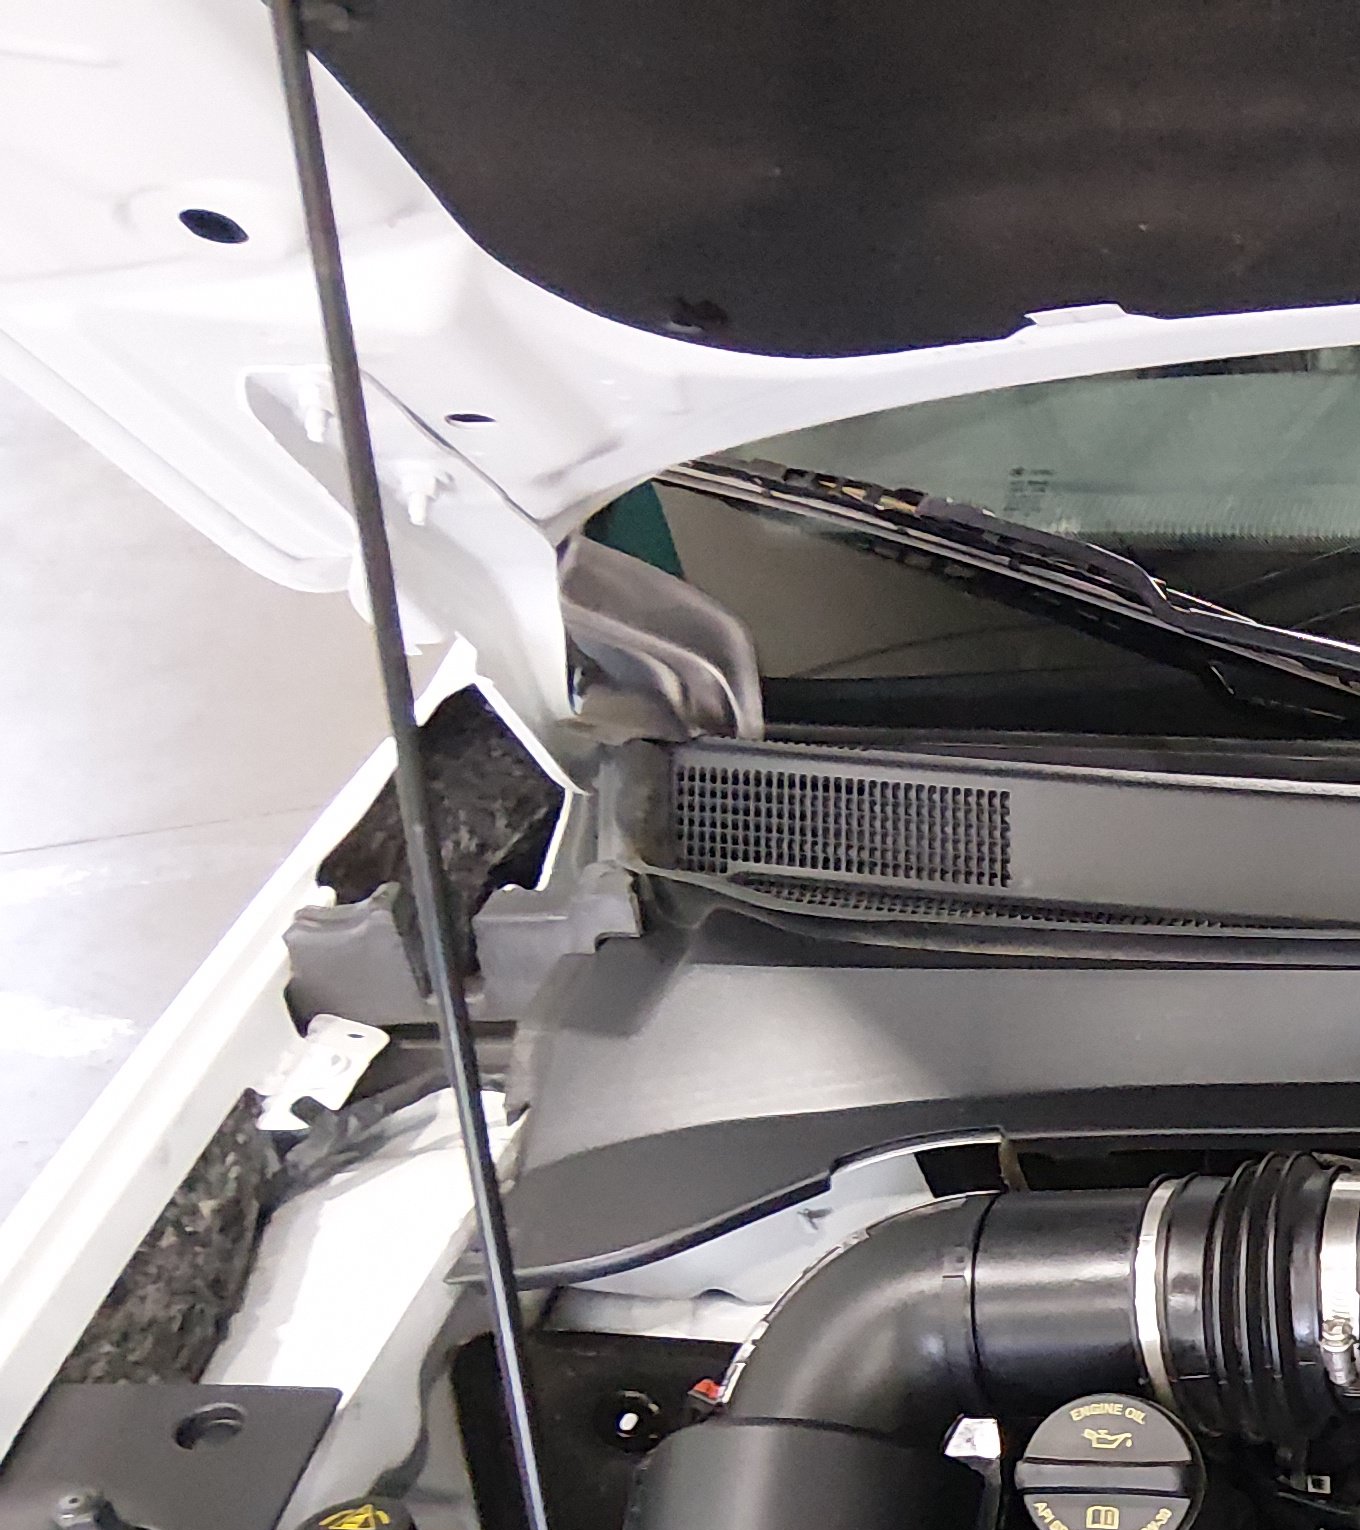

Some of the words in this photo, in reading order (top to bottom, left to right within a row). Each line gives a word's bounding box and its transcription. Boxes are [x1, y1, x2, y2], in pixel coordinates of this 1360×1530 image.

[1070, 1402, 1124, 1422] ENGINE
[1124, 1406, 1147, 1426] OIL
[1032, 1501, 1056, 1524] API
